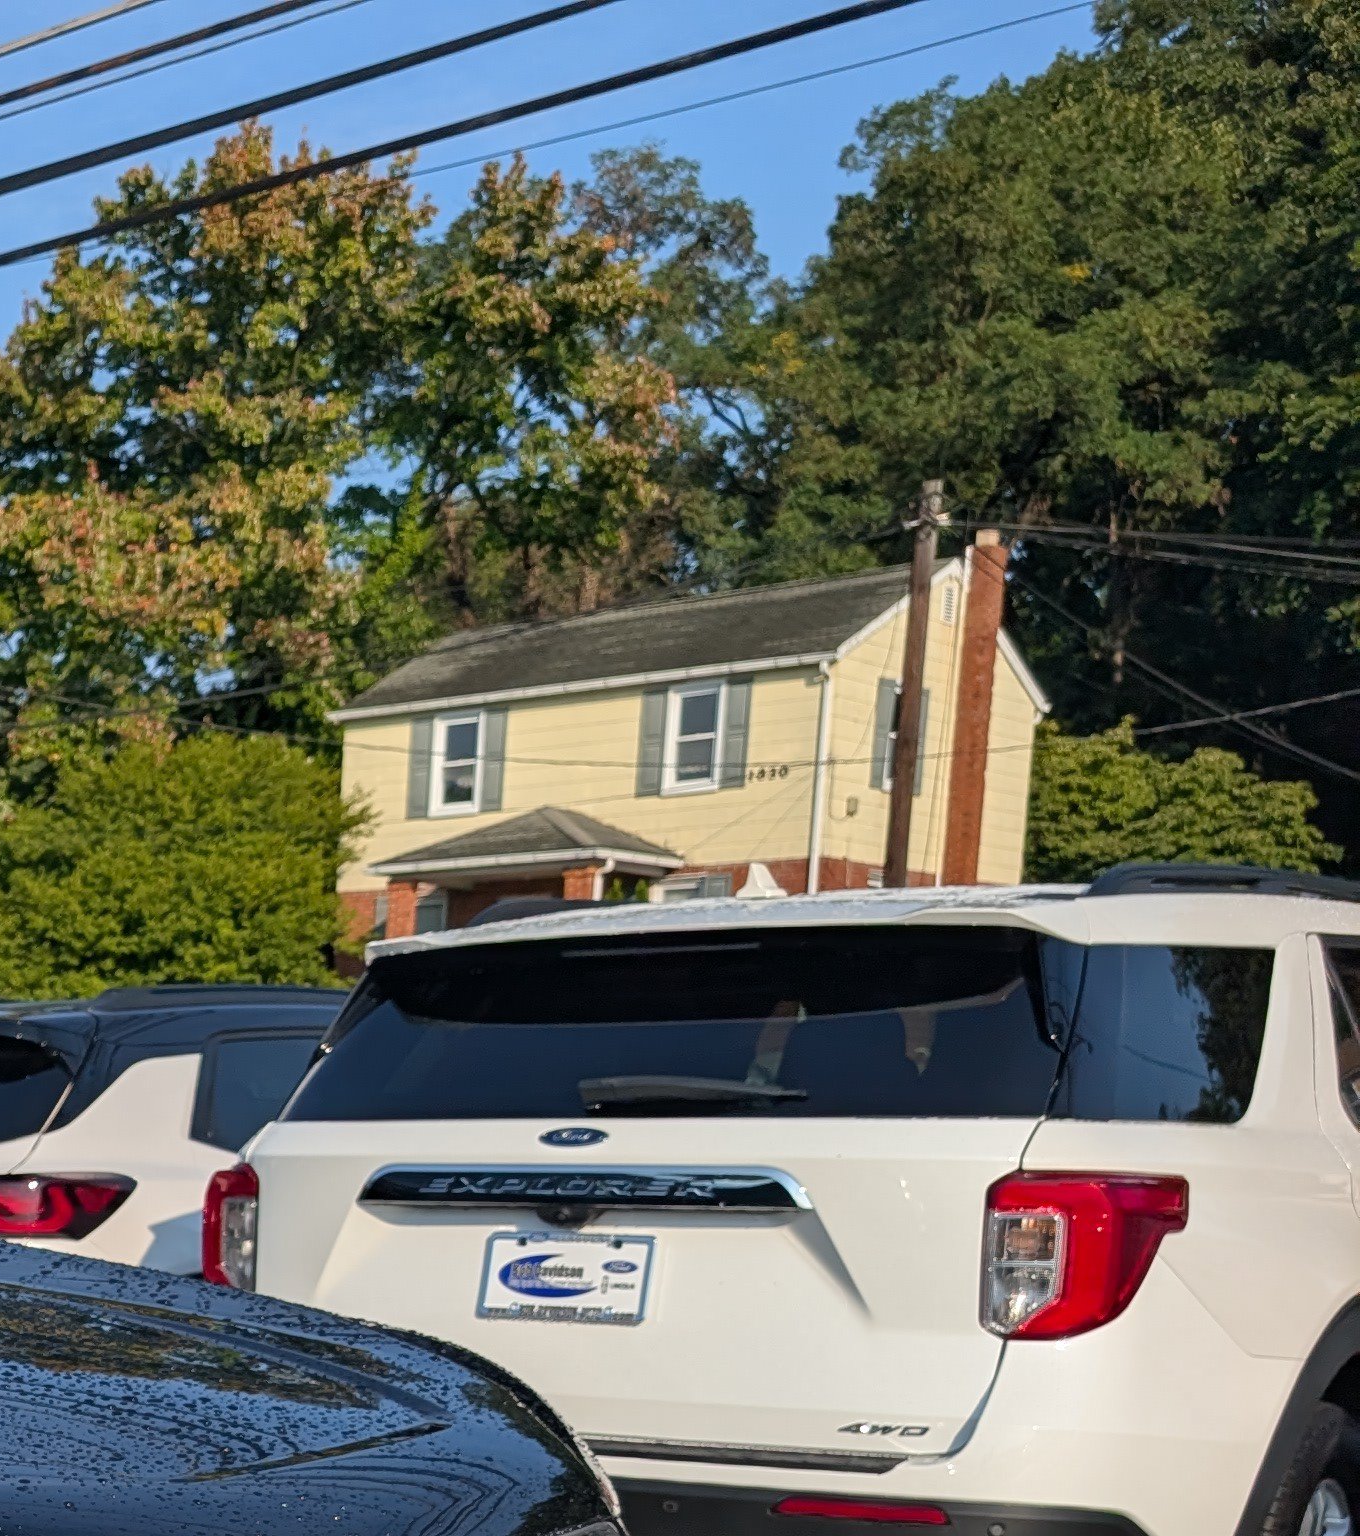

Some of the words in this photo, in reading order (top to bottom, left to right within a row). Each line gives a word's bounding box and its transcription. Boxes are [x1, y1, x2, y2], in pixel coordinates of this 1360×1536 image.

[552, 1129, 592, 1143] Ford
[418, 1175, 717, 1199] EXPLORER
[837, 1422, 930, 1437] 4WD
